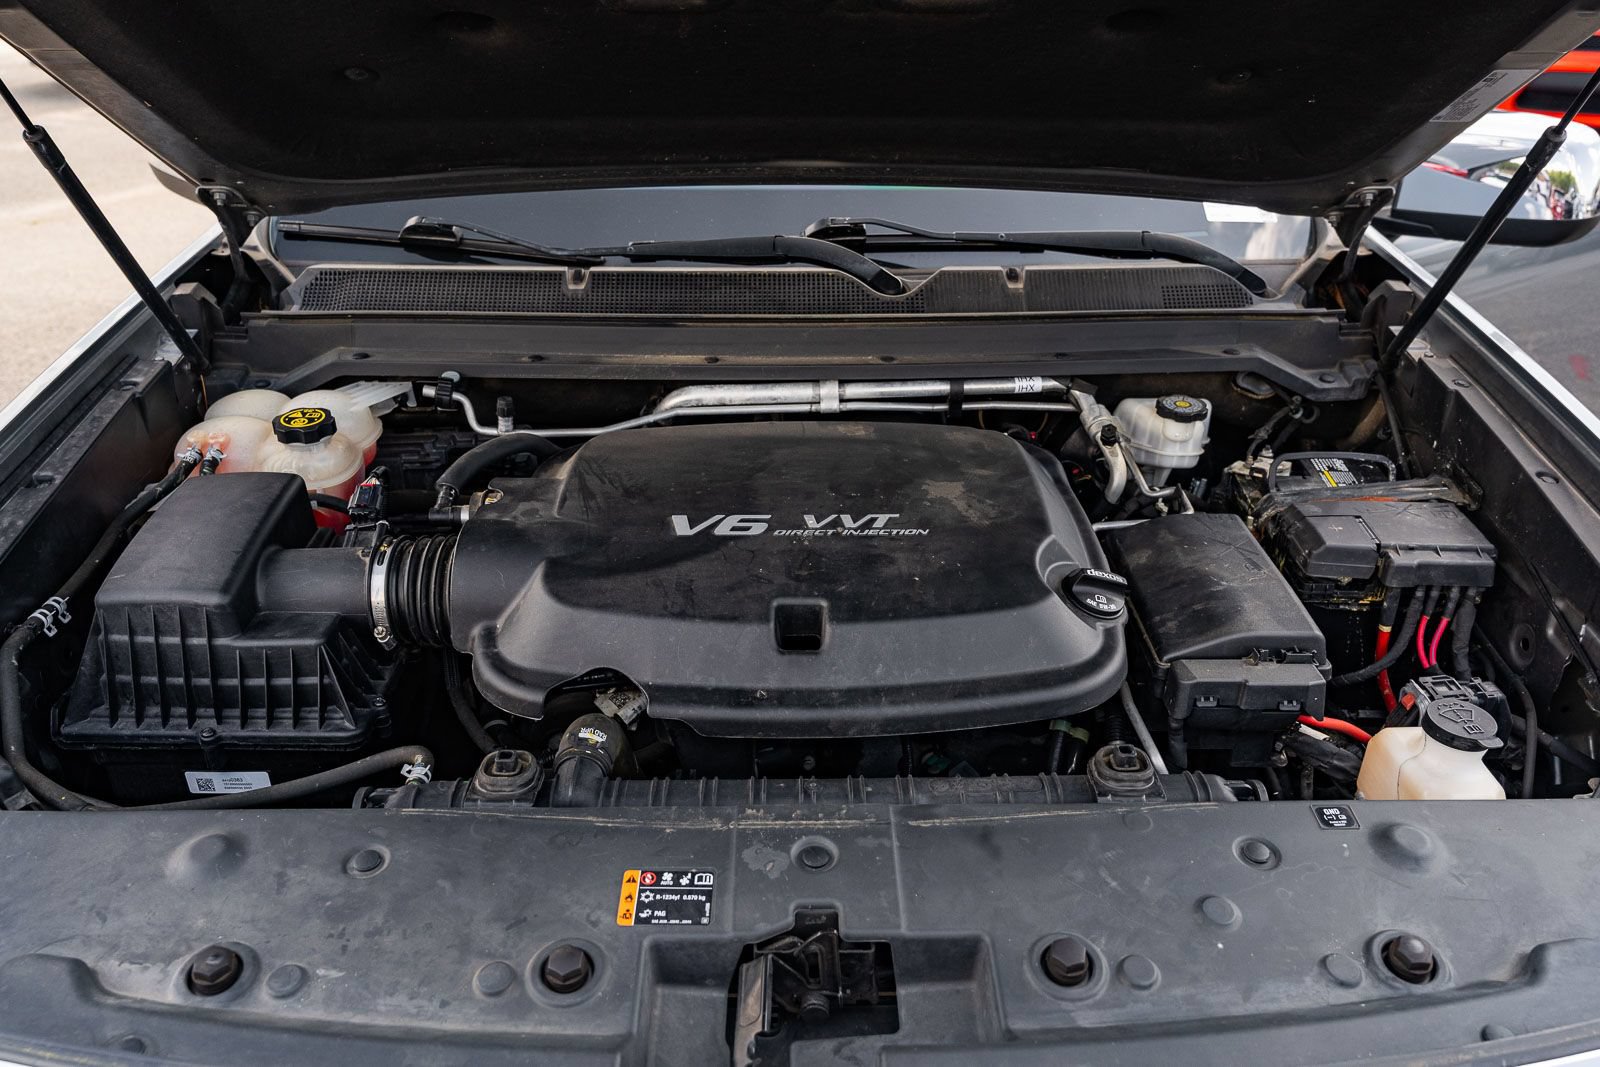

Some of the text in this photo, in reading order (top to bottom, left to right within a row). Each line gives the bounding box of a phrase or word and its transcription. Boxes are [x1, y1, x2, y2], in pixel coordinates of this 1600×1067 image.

[671, 513, 900, 536] V6 VVT
[594, 729, 608, 740] RAD
[698, 894, 707, 902] kg
